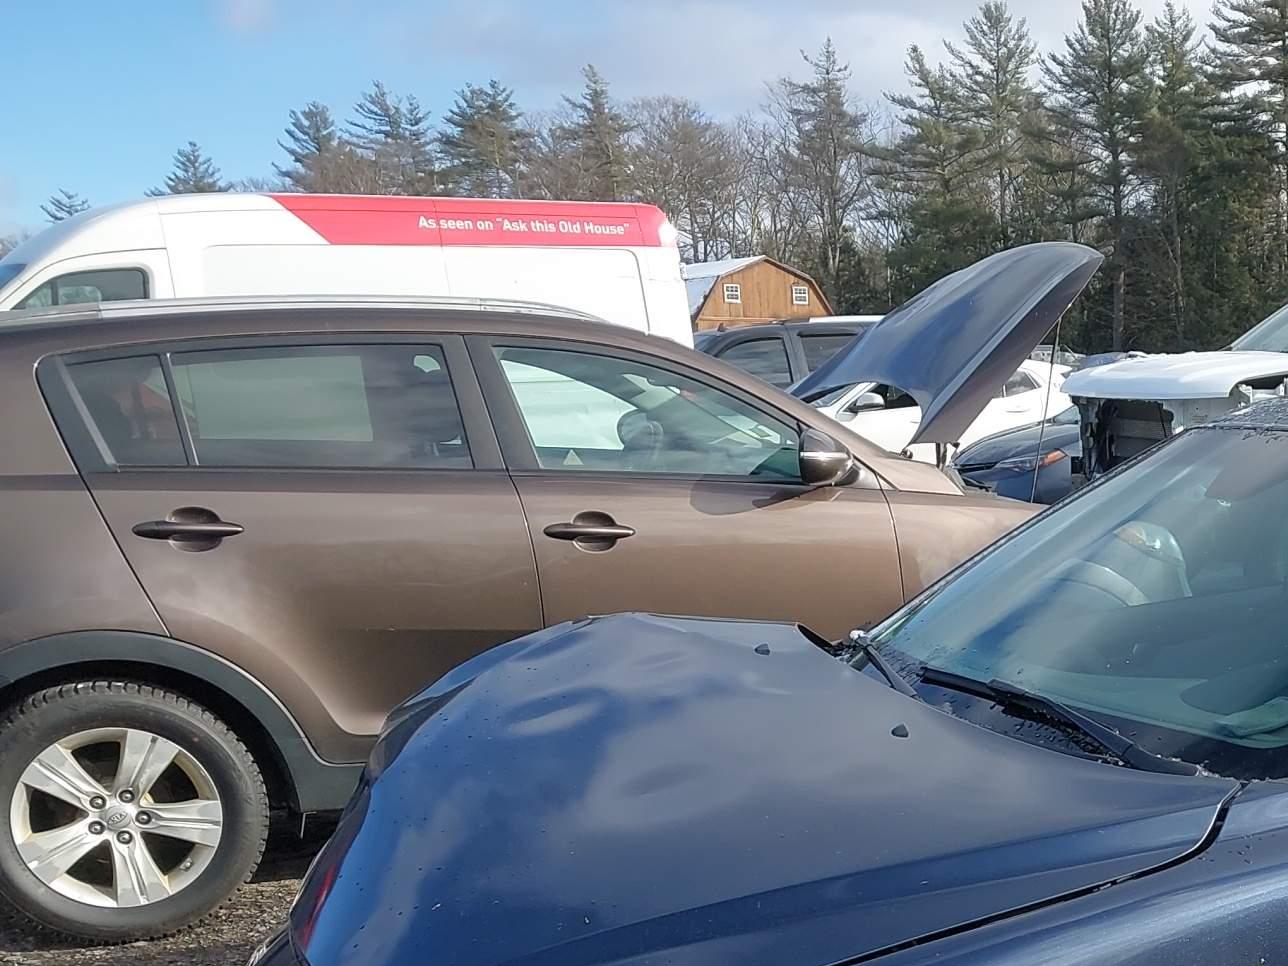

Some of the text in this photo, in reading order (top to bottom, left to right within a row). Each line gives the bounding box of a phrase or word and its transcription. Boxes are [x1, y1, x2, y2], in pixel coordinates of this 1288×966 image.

[418, 216, 436, 229] As
[439, 219, 473, 230] seen
[476, 220, 494, 231] on
[530, 220, 557, 233] this
[558, 220, 581, 234] Old
